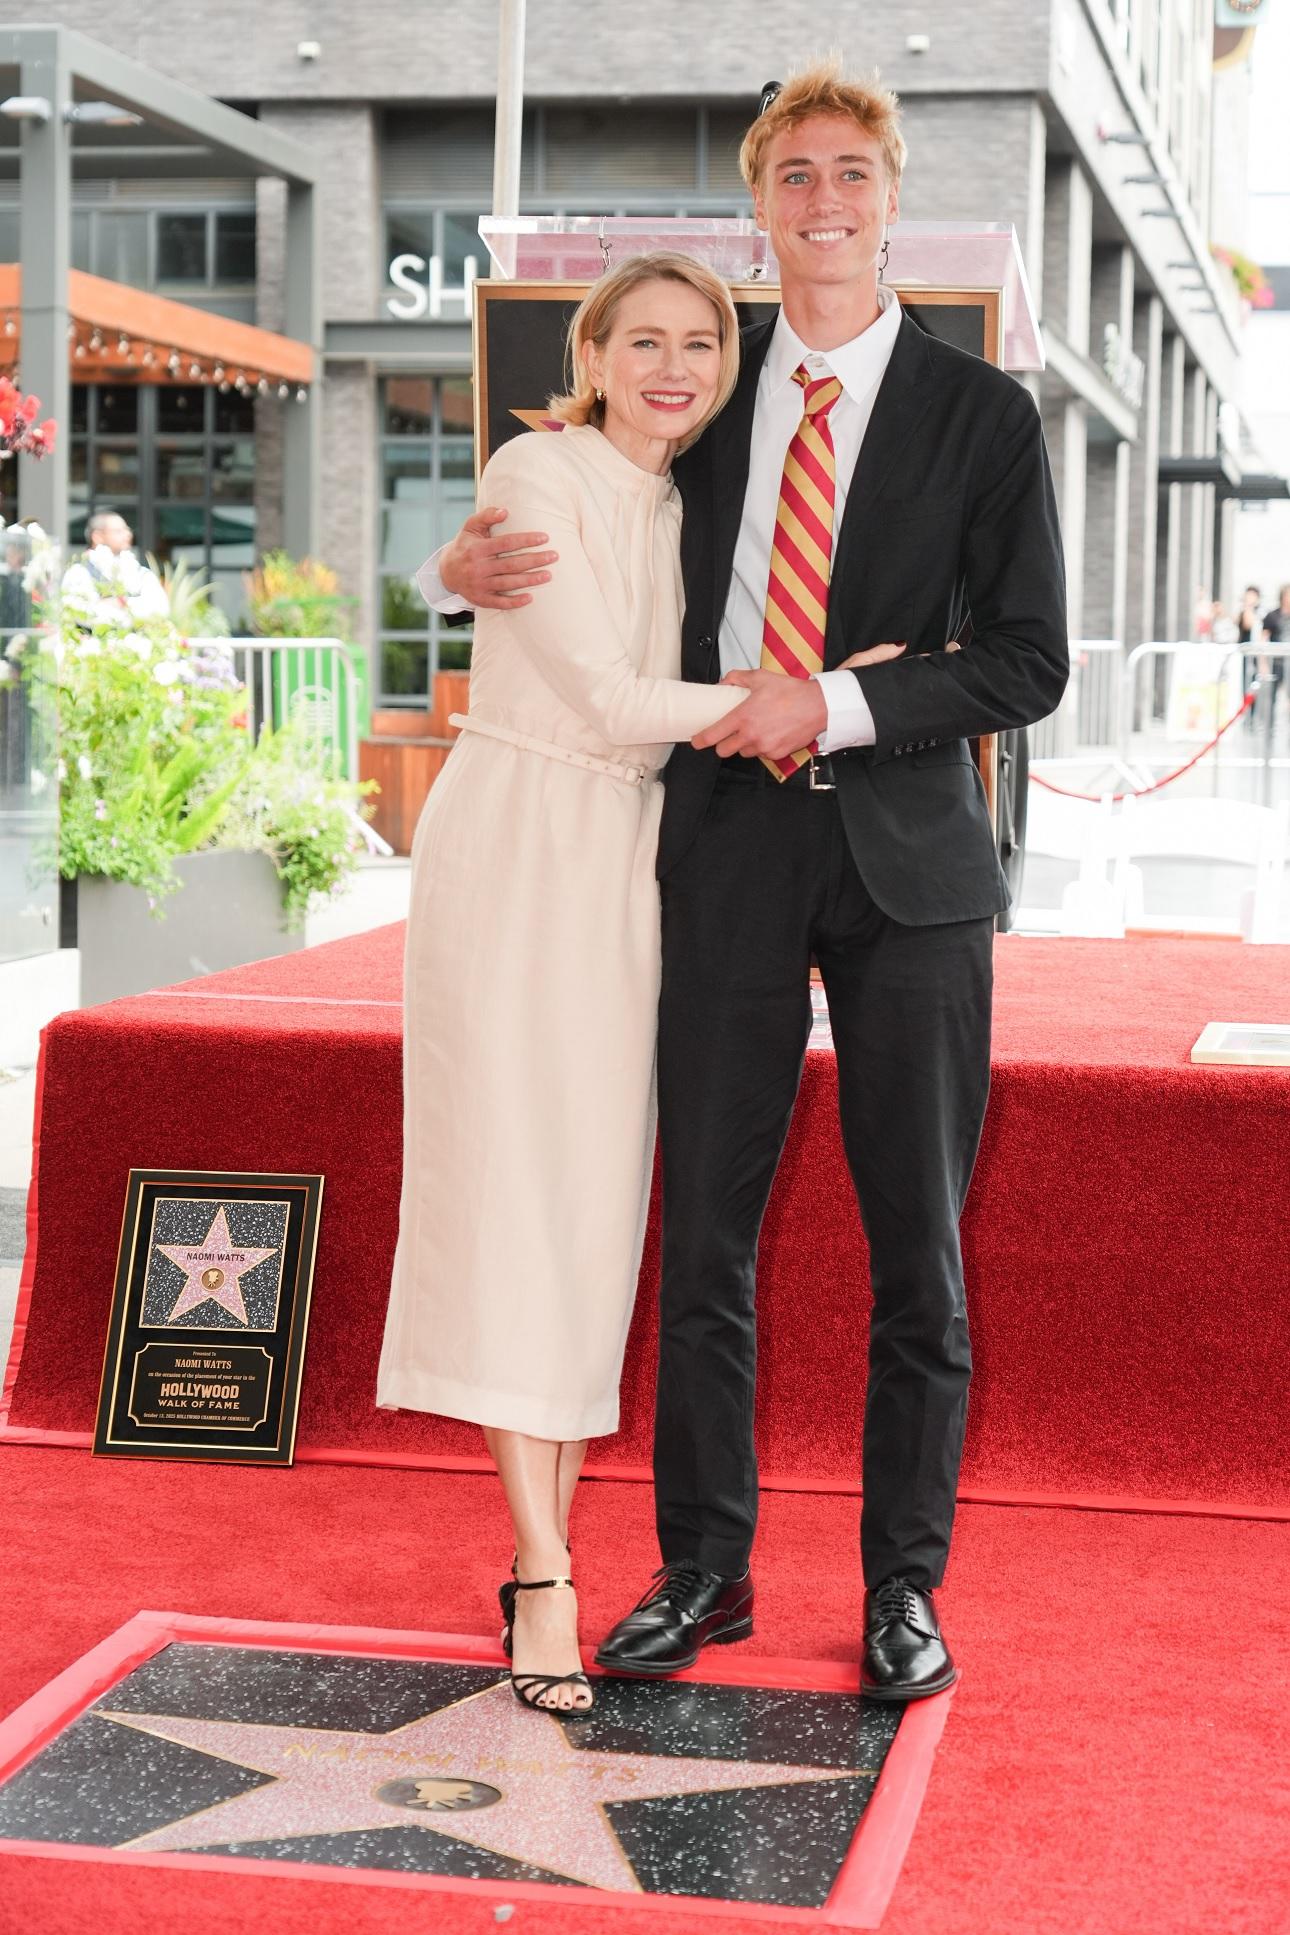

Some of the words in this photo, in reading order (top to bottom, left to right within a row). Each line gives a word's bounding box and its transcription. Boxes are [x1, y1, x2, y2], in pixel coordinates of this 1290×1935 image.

[387, 253, 477, 319] SH
[186, 1252, 215, 1261] NAOMI
[217, 1253, 245, 1262] WATTS
[175, 1358, 202, 1368] NAOMI
[203, 1359, 232, 1370] WATTS
[160, 1382, 240, 1399] HOLLYWOOD
[158, 1399, 188, 1408] WALK
[191, 1400, 206, 1408] OF
[208, 1401, 240, 1410] FAME
